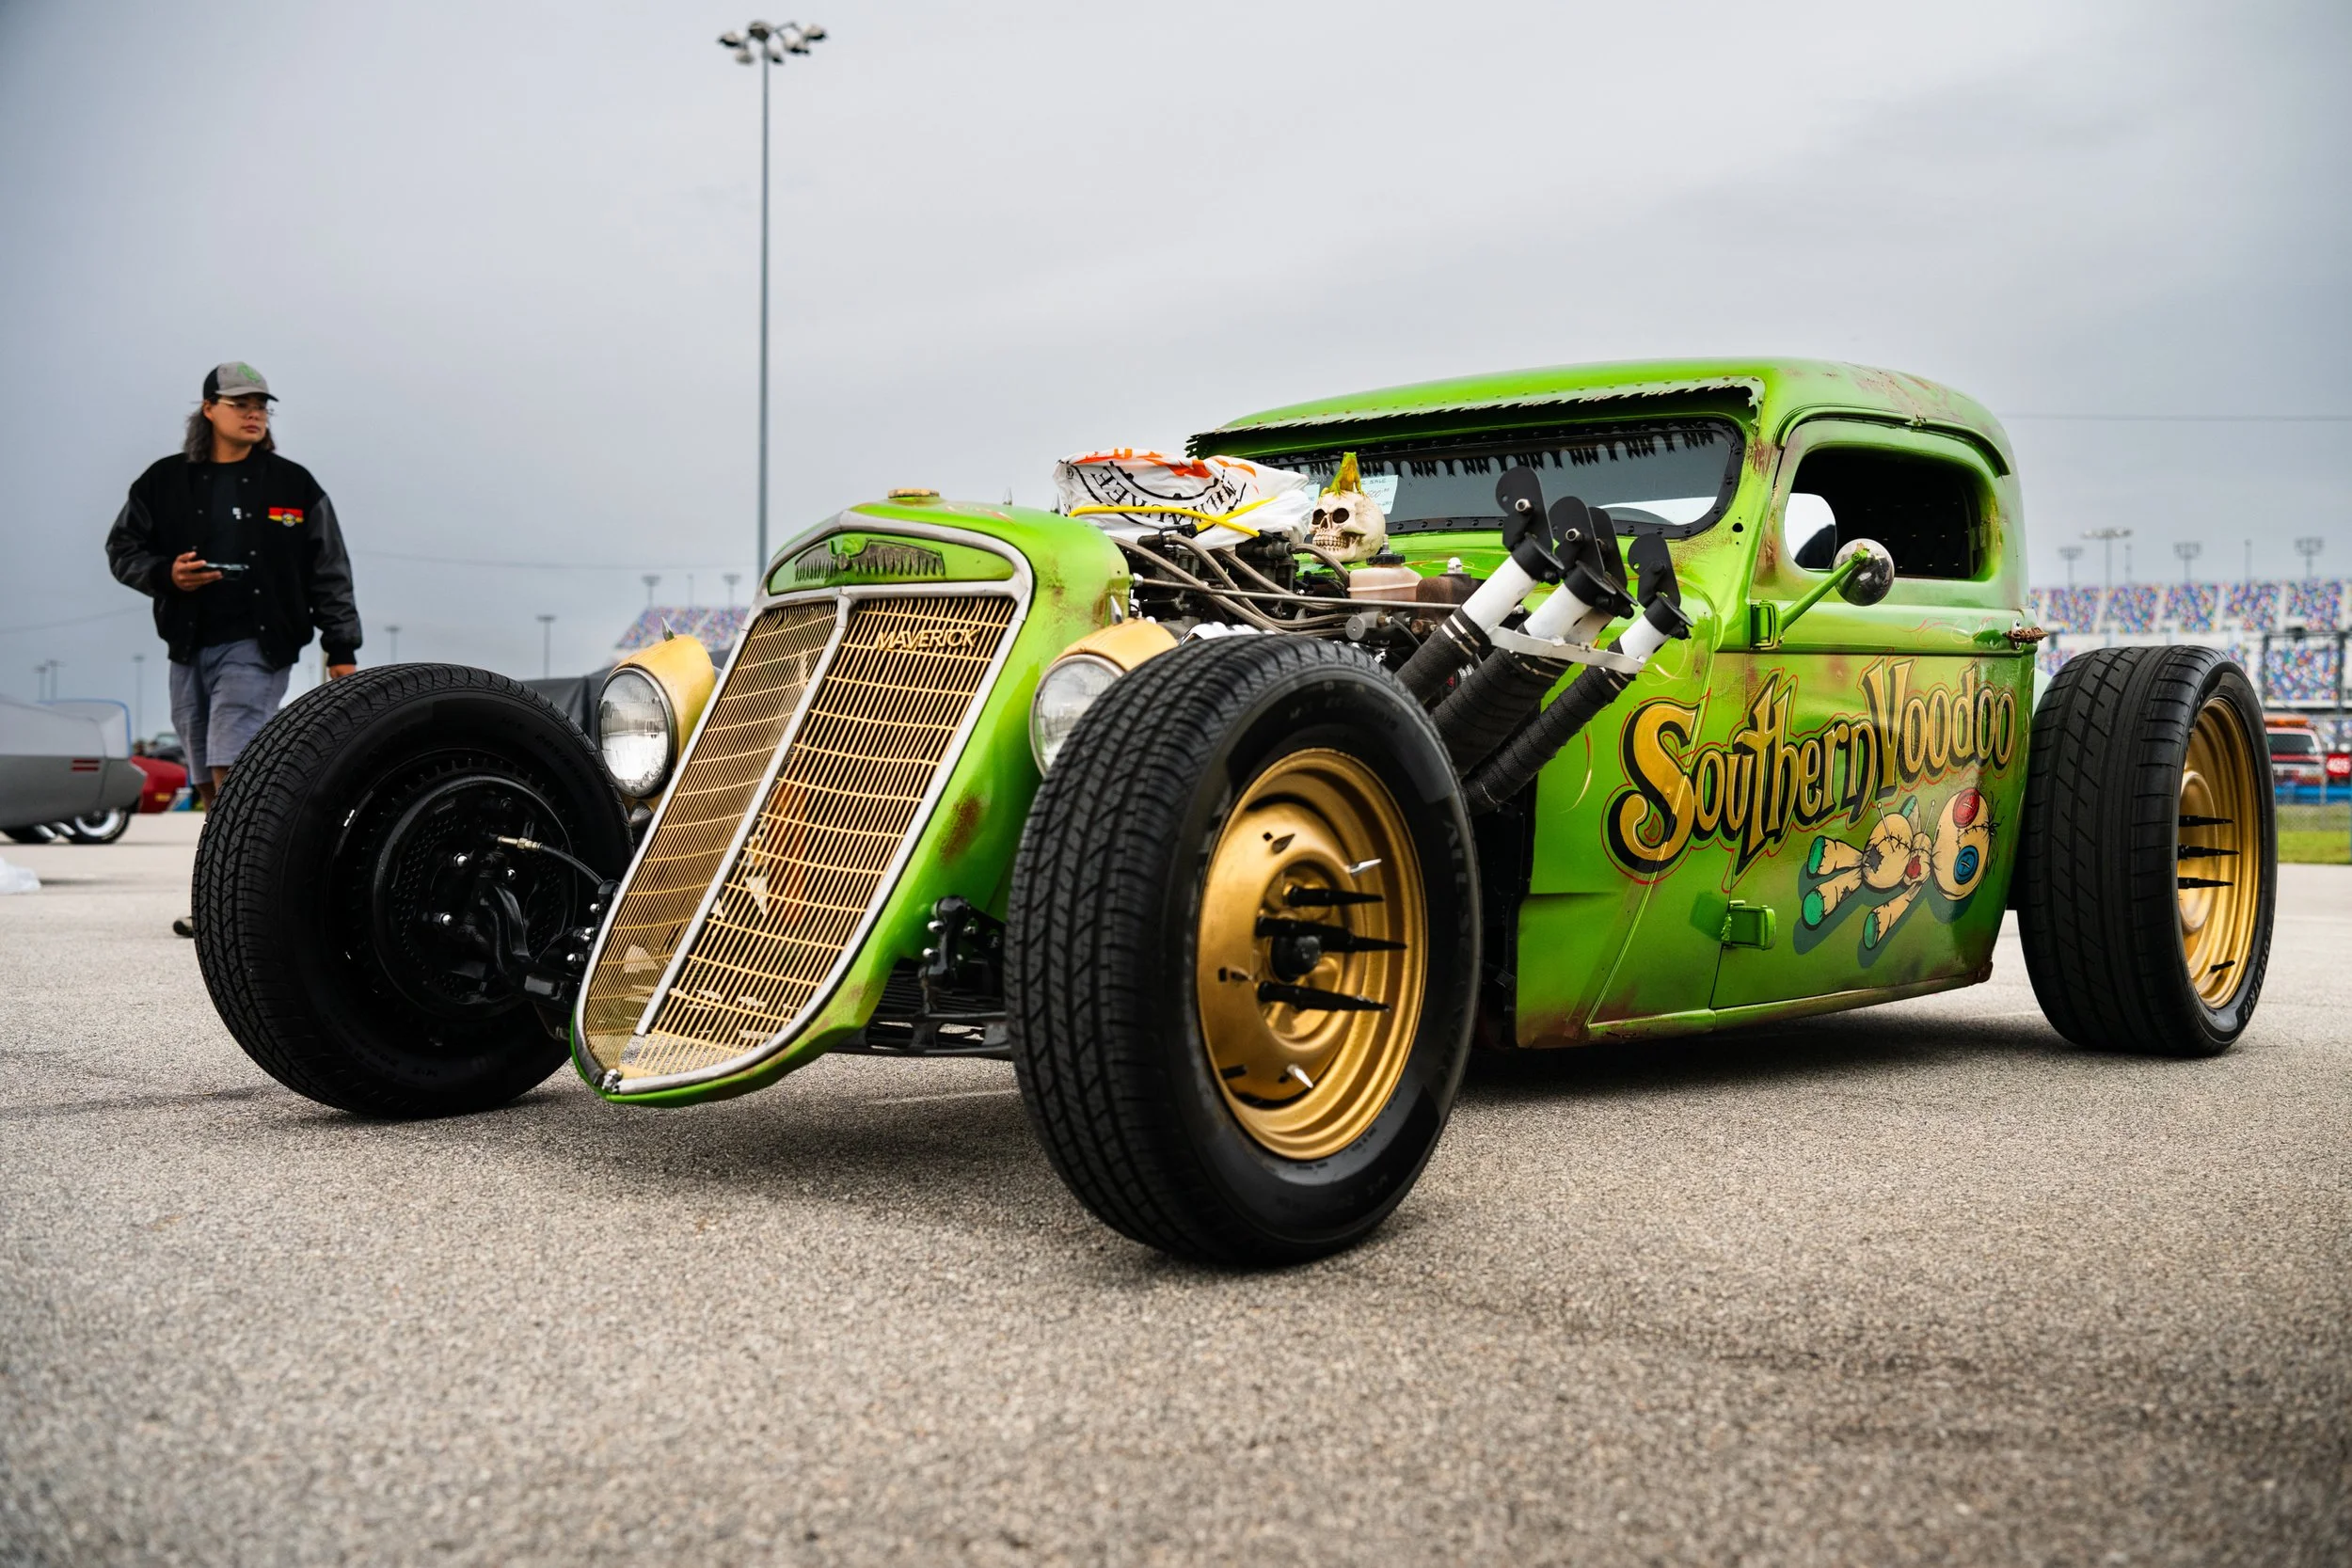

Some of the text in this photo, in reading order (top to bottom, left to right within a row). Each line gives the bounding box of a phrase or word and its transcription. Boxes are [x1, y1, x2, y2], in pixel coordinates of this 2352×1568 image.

[873, 628, 979, 652] MAVERICK
[1609, 657, 2016, 876] Southern Voodoo
